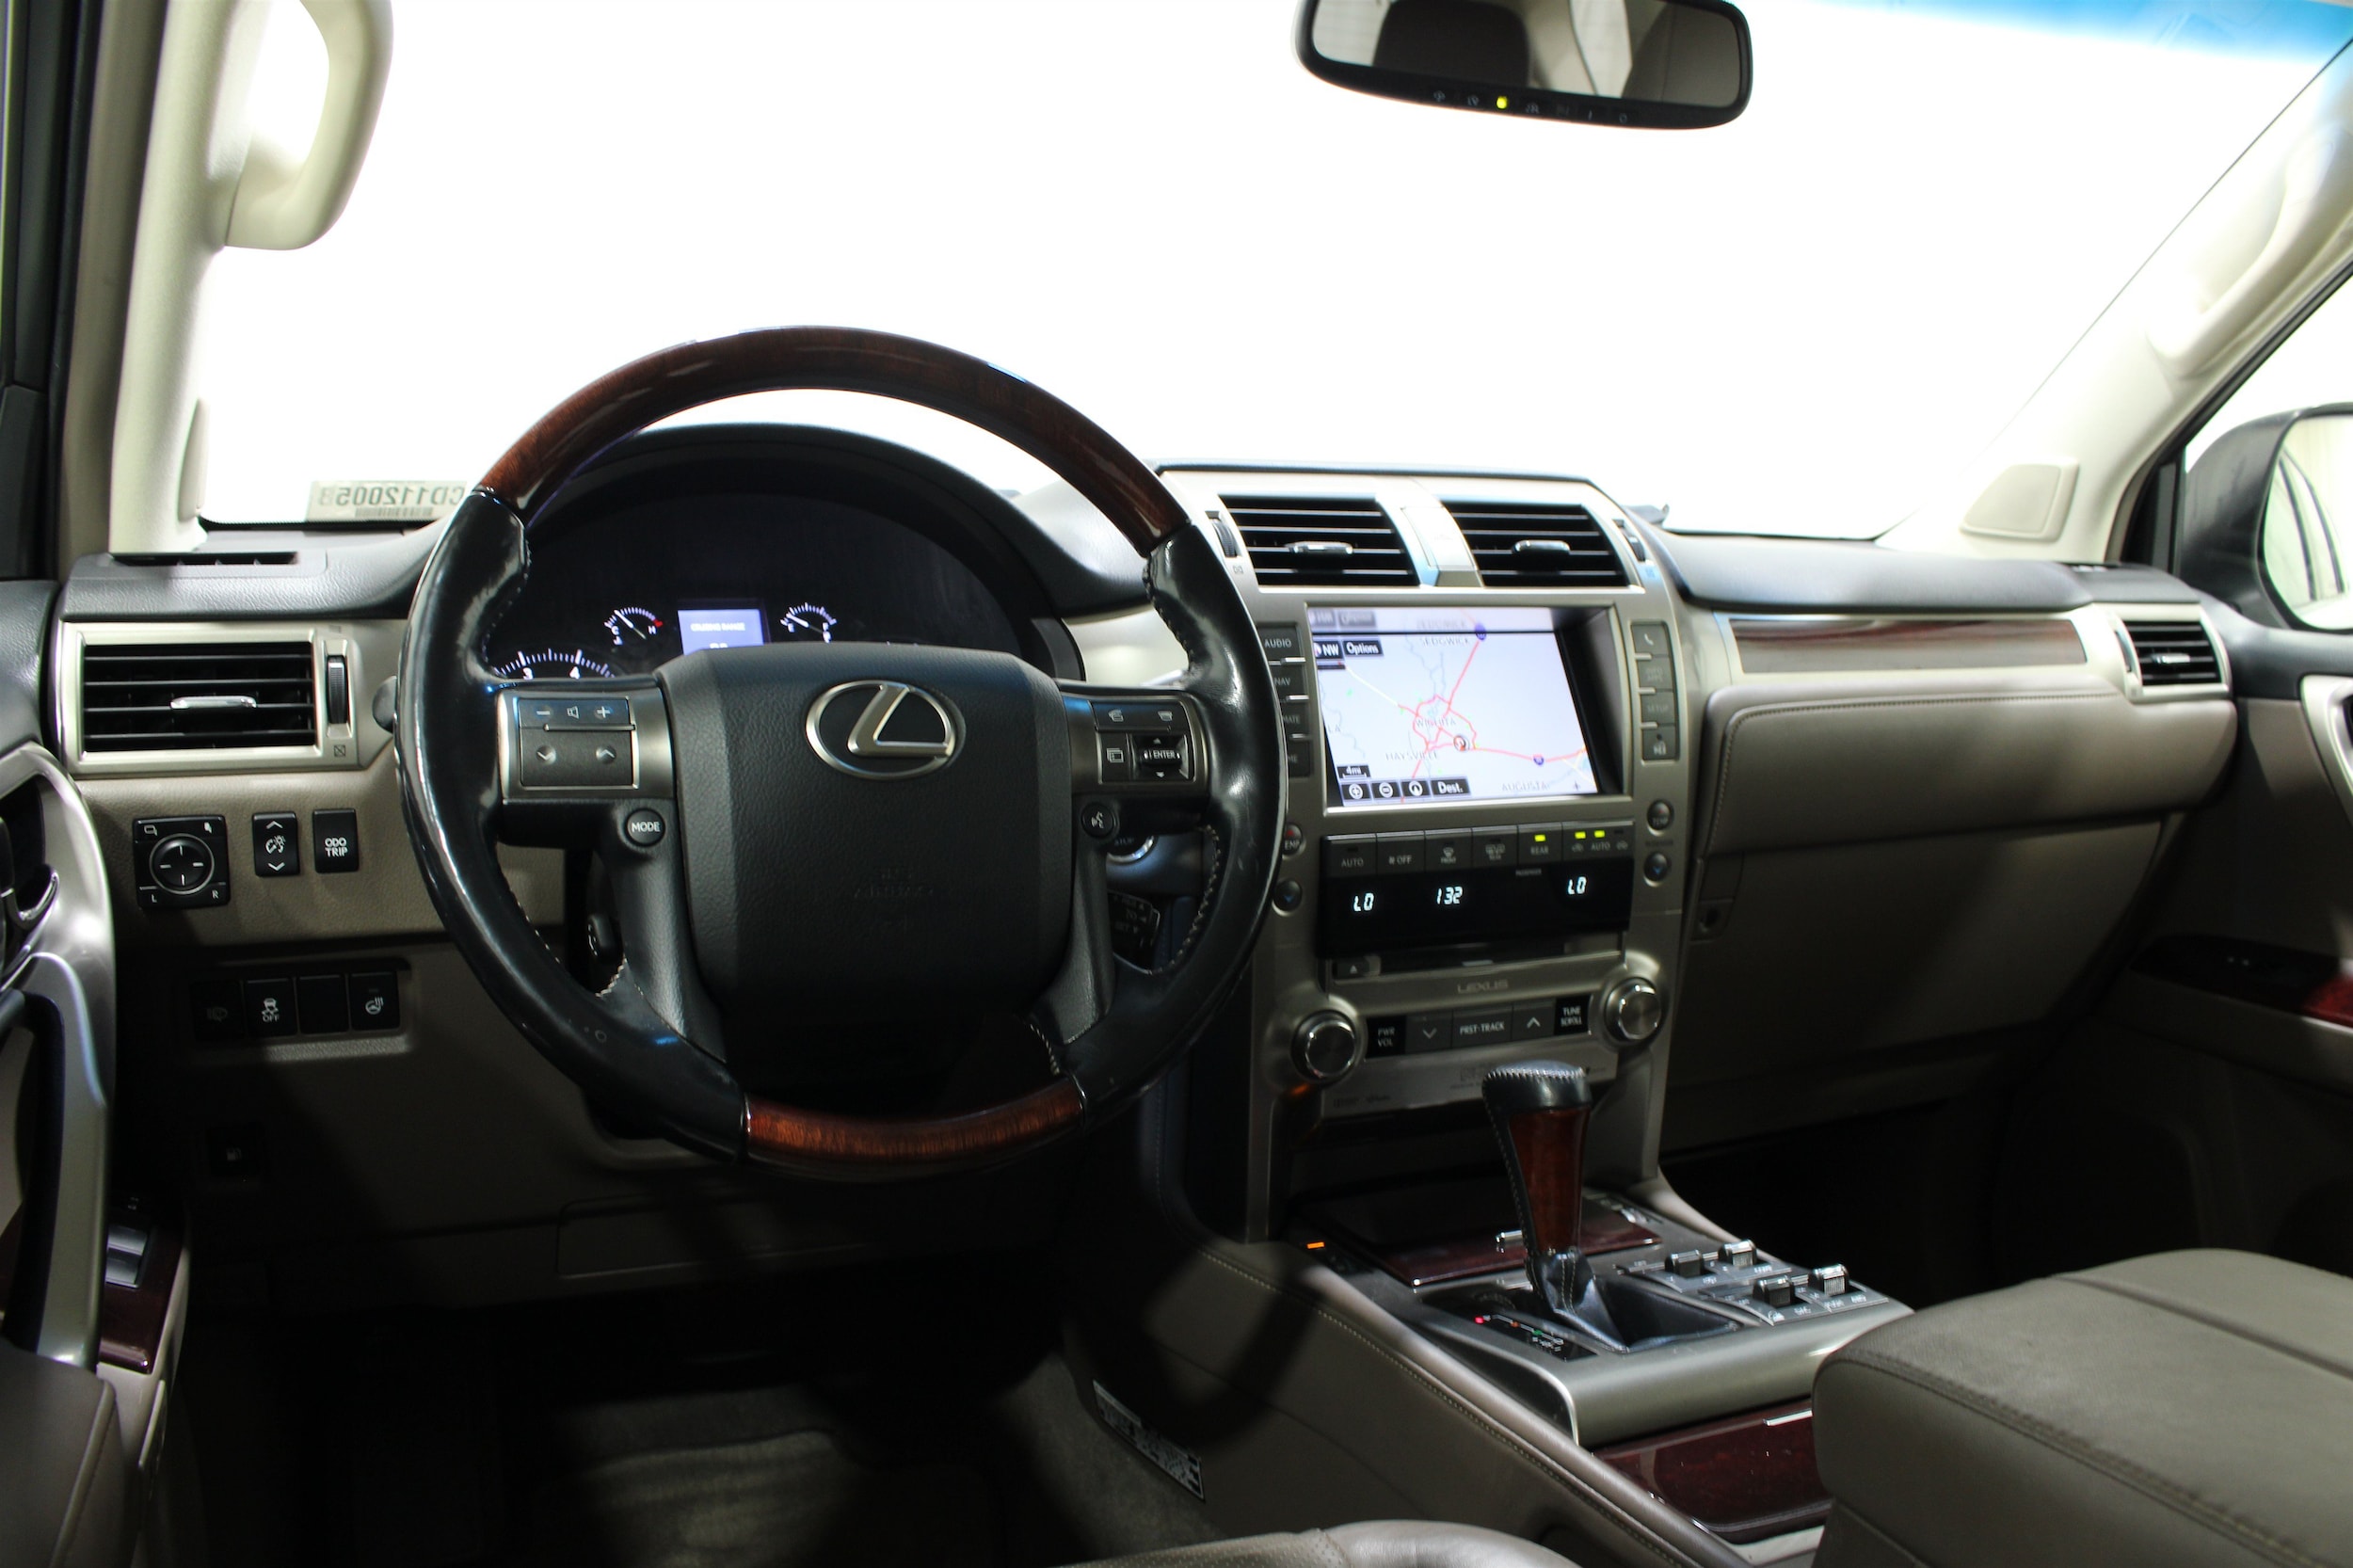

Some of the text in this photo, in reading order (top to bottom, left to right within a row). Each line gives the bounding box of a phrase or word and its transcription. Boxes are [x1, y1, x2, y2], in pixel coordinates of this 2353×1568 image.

[1264, 638, 1292, 648] AUDIO
[1346, 642, 1380, 655] Options
[1322, 644, 1339, 656] NW
[569, 666, 581, 680] 4
[1153, 749, 1176, 760] ENTER
[632, 821, 661, 833] MODE
[325, 837, 347, 848] ODO
[1591, 841, 1610, 851] AUTO
[325, 846, 348, 857] TRIP
[1341, 858, 1364, 868] AUTO
[1397, 855, 1412, 865] OFF
[212, 889, 219, 900] R
[1457, 979, 1509, 994] LEXUS
[262, 1013, 280, 1023] OFF
[1378, 1027, 1396, 1037] PWR
[1378, 1037, 1394, 1048] VOL
